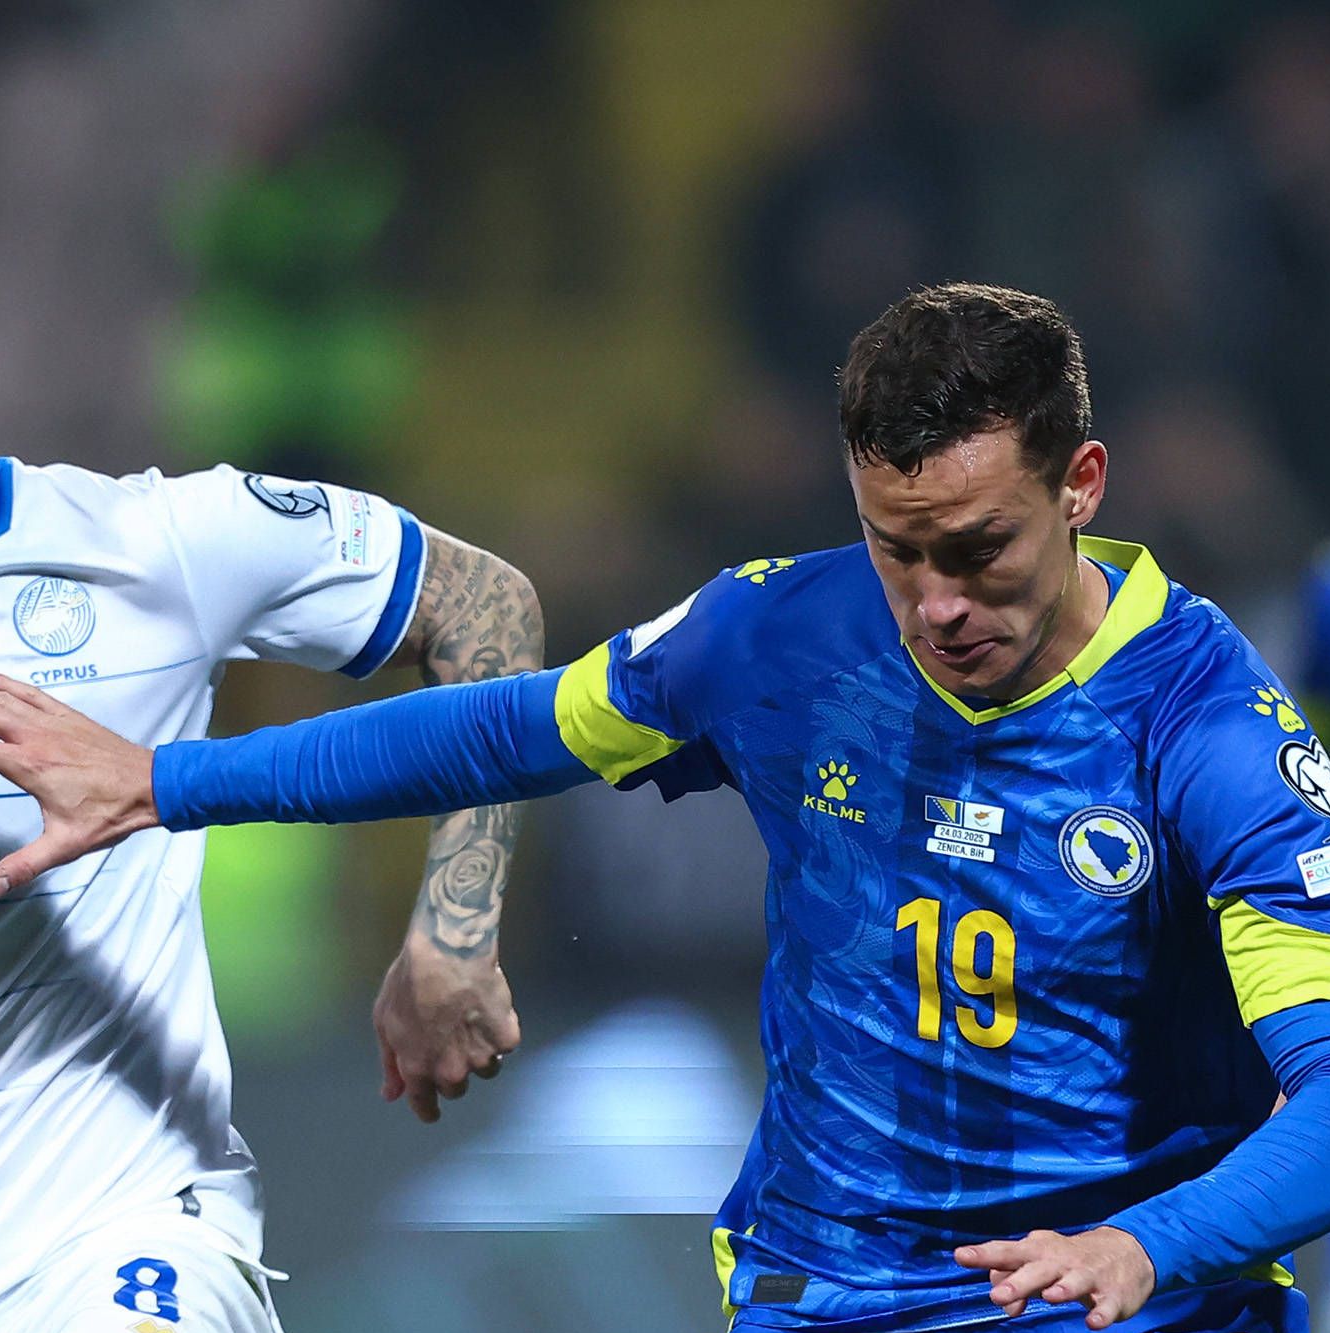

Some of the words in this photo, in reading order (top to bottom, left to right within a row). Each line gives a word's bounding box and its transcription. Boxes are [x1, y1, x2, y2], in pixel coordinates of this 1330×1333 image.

[30, 663, 99, 685] CYPRUS
[803, 794, 867, 824] KELME
[939, 826, 985, 844] 24.03.2025
[895, 897, 1018, 1048] 19
[113, 1256, 182, 1324] 8
